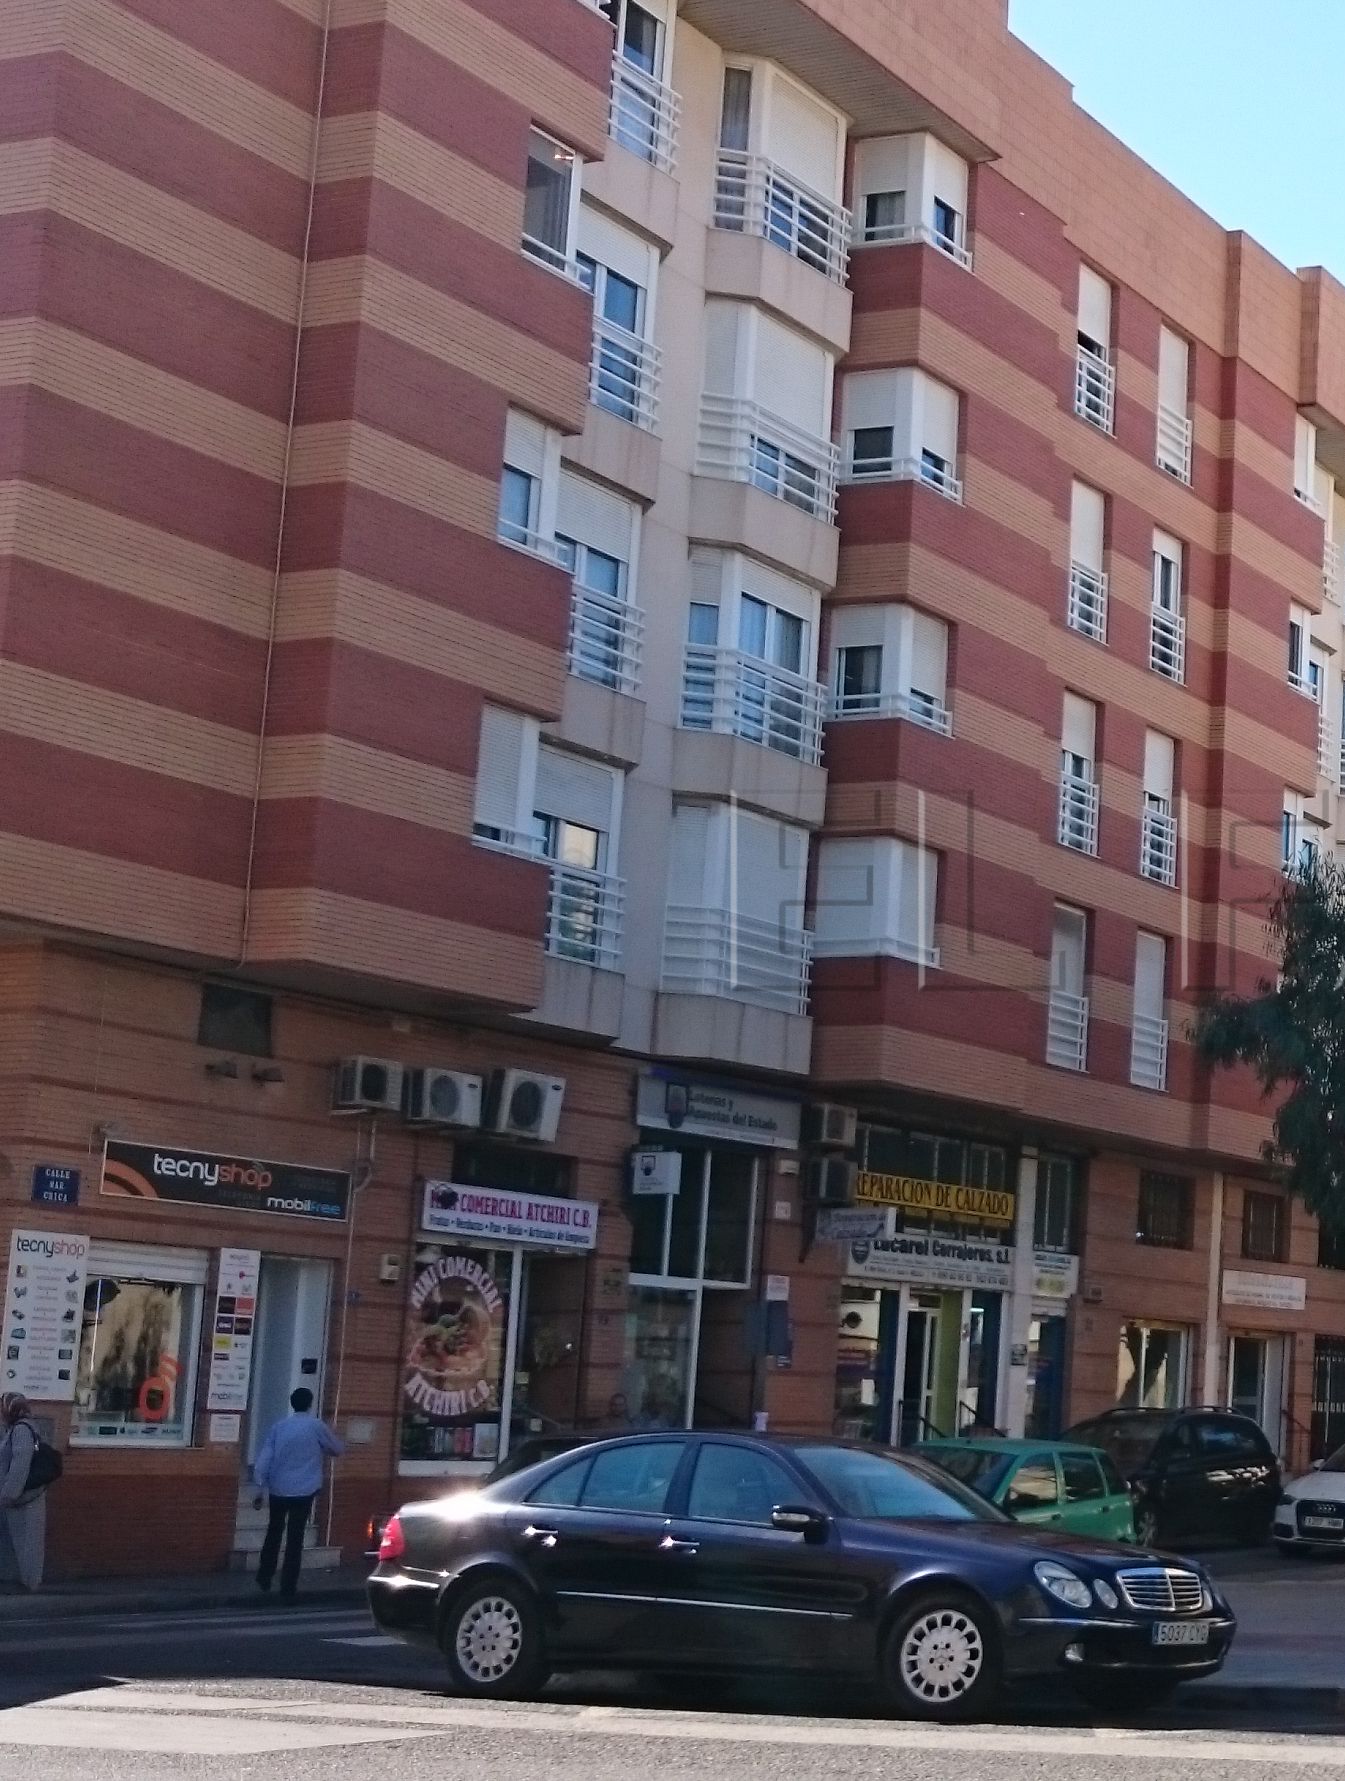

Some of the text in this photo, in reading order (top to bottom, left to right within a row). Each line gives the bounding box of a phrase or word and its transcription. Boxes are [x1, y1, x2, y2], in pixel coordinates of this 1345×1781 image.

[748, 1115, 777, 1131] Estado
[46, 1168, 71, 1179] CALLE
[152, 1153, 272, 1191] tecnyshop
[43, 1191, 68, 1202] CHICA
[49, 1180, 65, 1190] MAR
[267, 1196, 340, 1215] mobilfree
[461, 1193, 523, 1219] COMERCIAL
[526, 1202, 570, 1226] ATCHIRI
[936, 1186, 950, 1207] DE
[956, 1188, 1009, 1216] CALZADO
[17, 1236, 85, 1259] tecnyshop
[411, 1256, 502, 1313] MINI COMERCIAL
[404, 1372, 468, 1416] ATCHIRI
